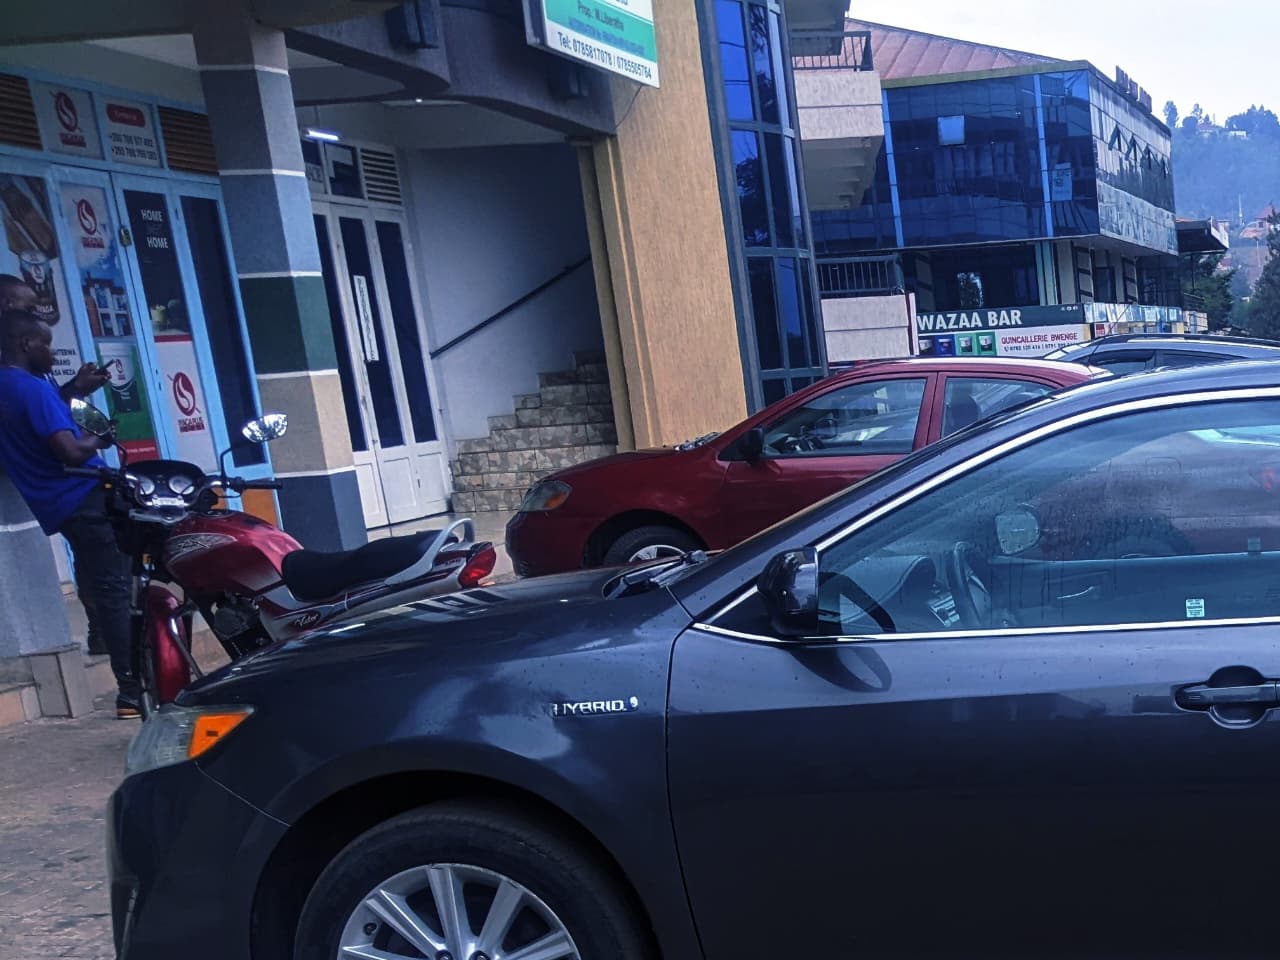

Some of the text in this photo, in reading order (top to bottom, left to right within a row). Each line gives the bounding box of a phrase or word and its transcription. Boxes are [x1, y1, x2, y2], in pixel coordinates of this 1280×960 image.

[557, 31, 572, 49] Tel:
[141, 208, 163, 222] HOME
[147, 237, 169, 249] HOME
[916, 309, 1022, 331] WAZAA BAR
[1001, 334, 1048, 345] QUINCAILLERIE
[1050, 332, 1078, 342] BWENGE
[552, 699, 625, 717] HYBRID
